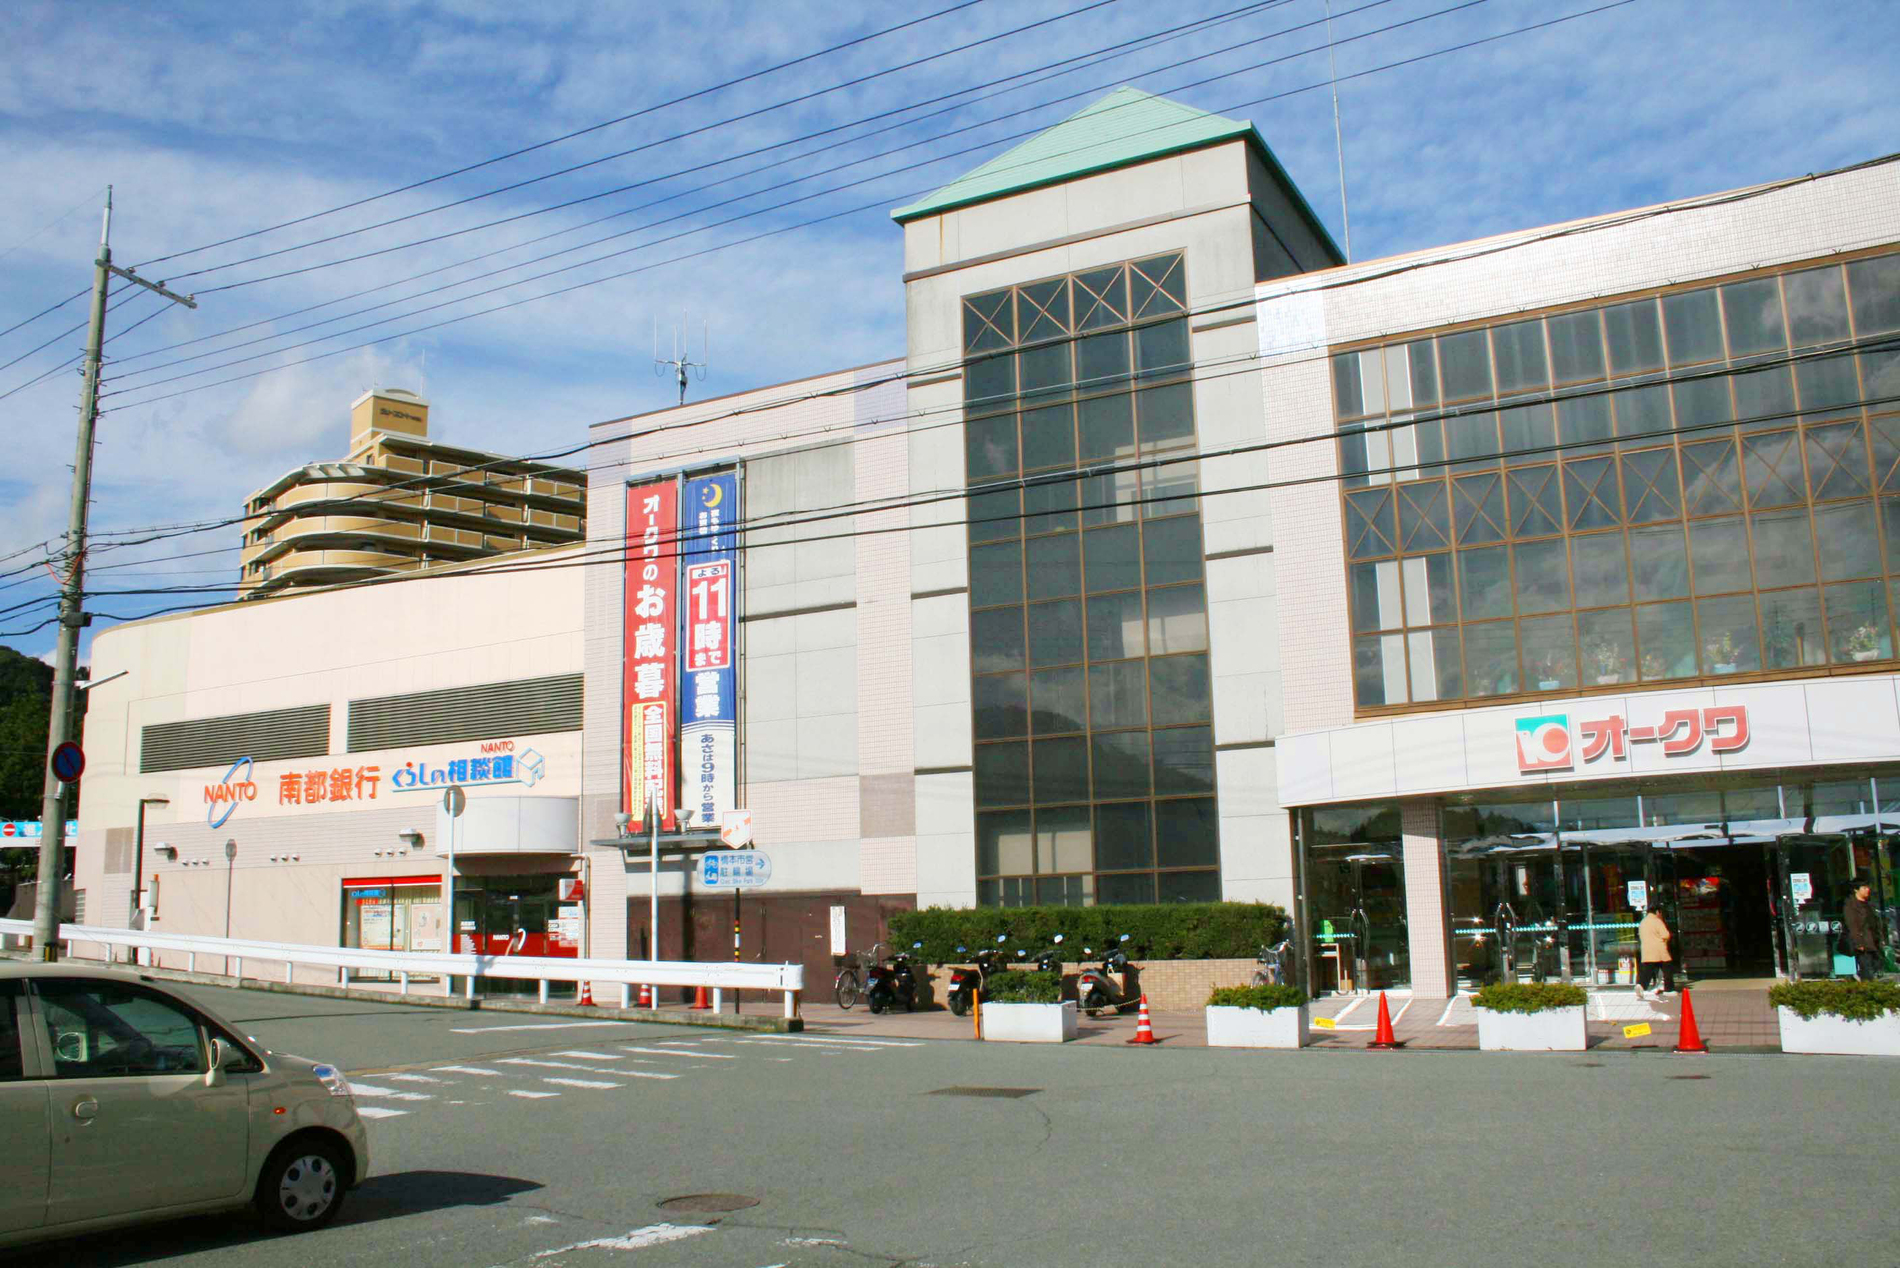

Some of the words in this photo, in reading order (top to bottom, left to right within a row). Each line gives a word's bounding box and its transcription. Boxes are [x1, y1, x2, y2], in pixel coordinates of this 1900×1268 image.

[481, 741, 515, 754] NANTO
[1580, 704, 1751, 764] オークワ
[279, 766, 381, 805] 南都銀行
[391, 754, 514, 788] くらしの相談館
[700, 733, 715, 823] あさは9時から営業
[204, 781, 258, 804] NANTO
